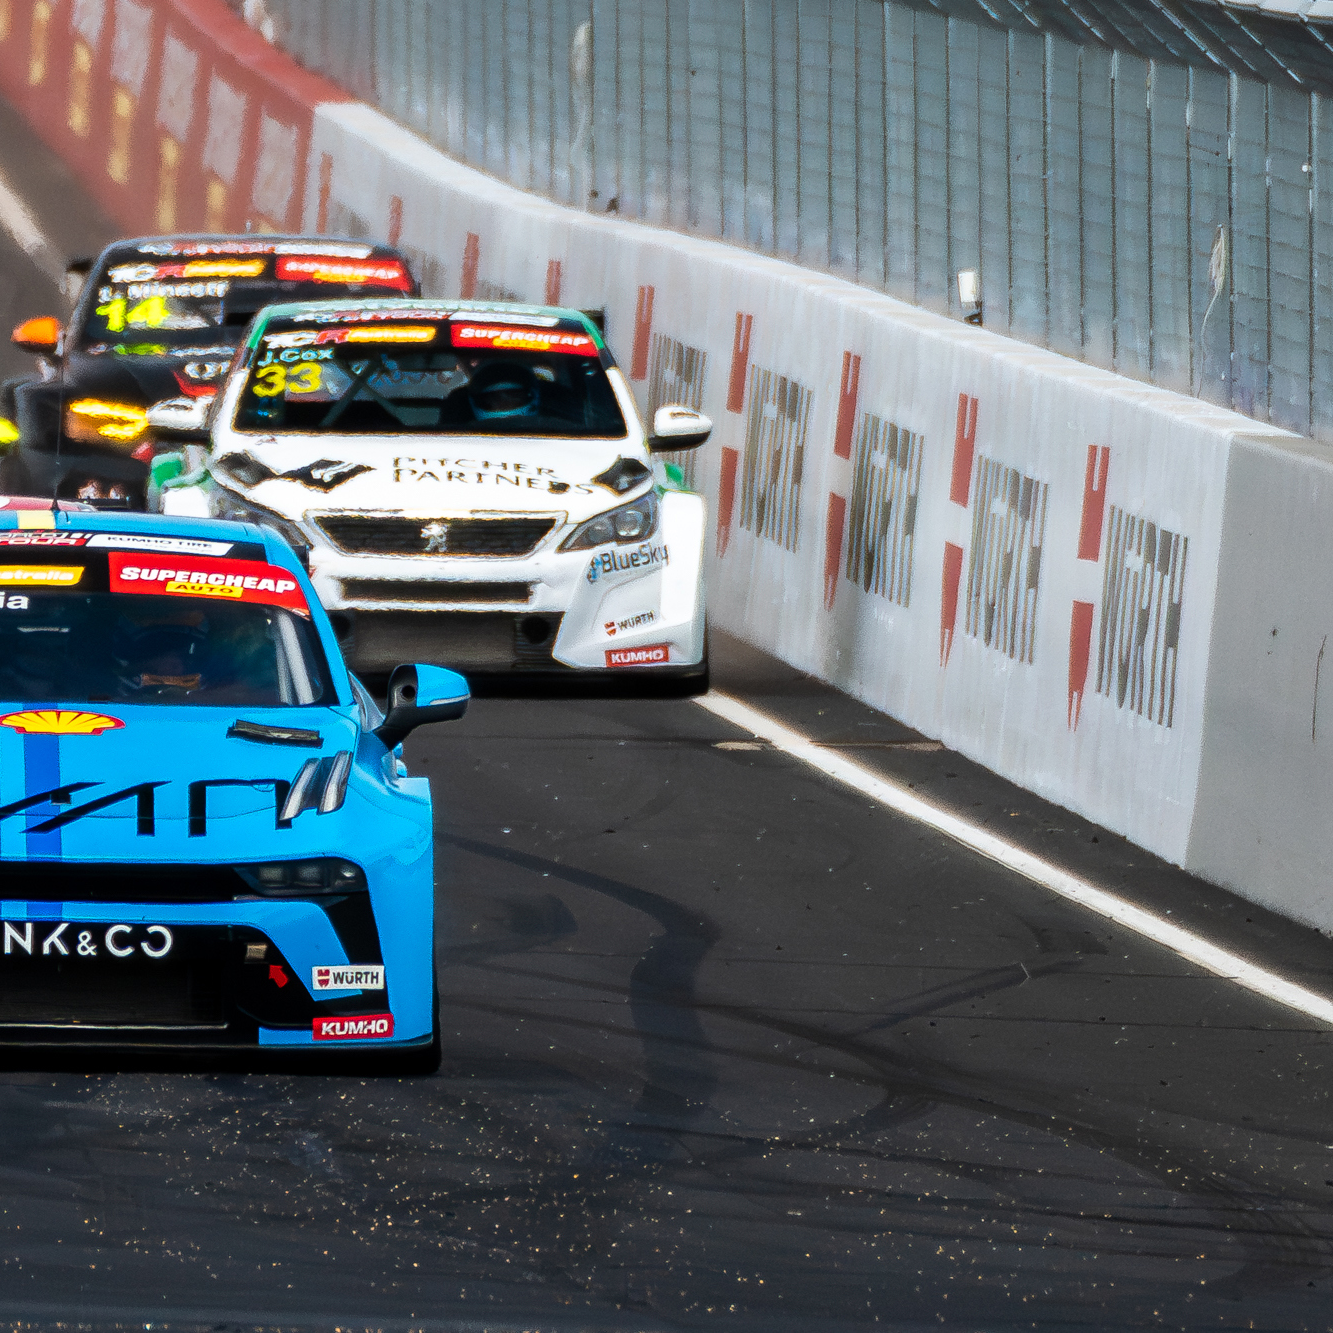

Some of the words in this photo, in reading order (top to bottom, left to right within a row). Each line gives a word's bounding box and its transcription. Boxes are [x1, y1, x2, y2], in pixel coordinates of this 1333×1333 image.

[95, 296, 170, 333] 14
[459, 327, 588, 348] SUPERCHEAP
[258, 347, 334, 366] J.Cox
[252, 361, 323, 398] 33
[392, 456, 558, 479] PITCHER
[107, 535, 166, 546] KUMHO
[172, 539, 214, 549] TIRE
[600, 542, 671, 574] BlueSky
[120, 567, 296, 594] SUPERCHEAP
[174, 582, 233, 594] AUTO
[1094, 503, 1190, 730] WÜRTH
[611, 649, 664, 665] KUMHO
[332, 970, 380, 986] WÜRTH
[320, 1018, 389, 1036] KUMHO
